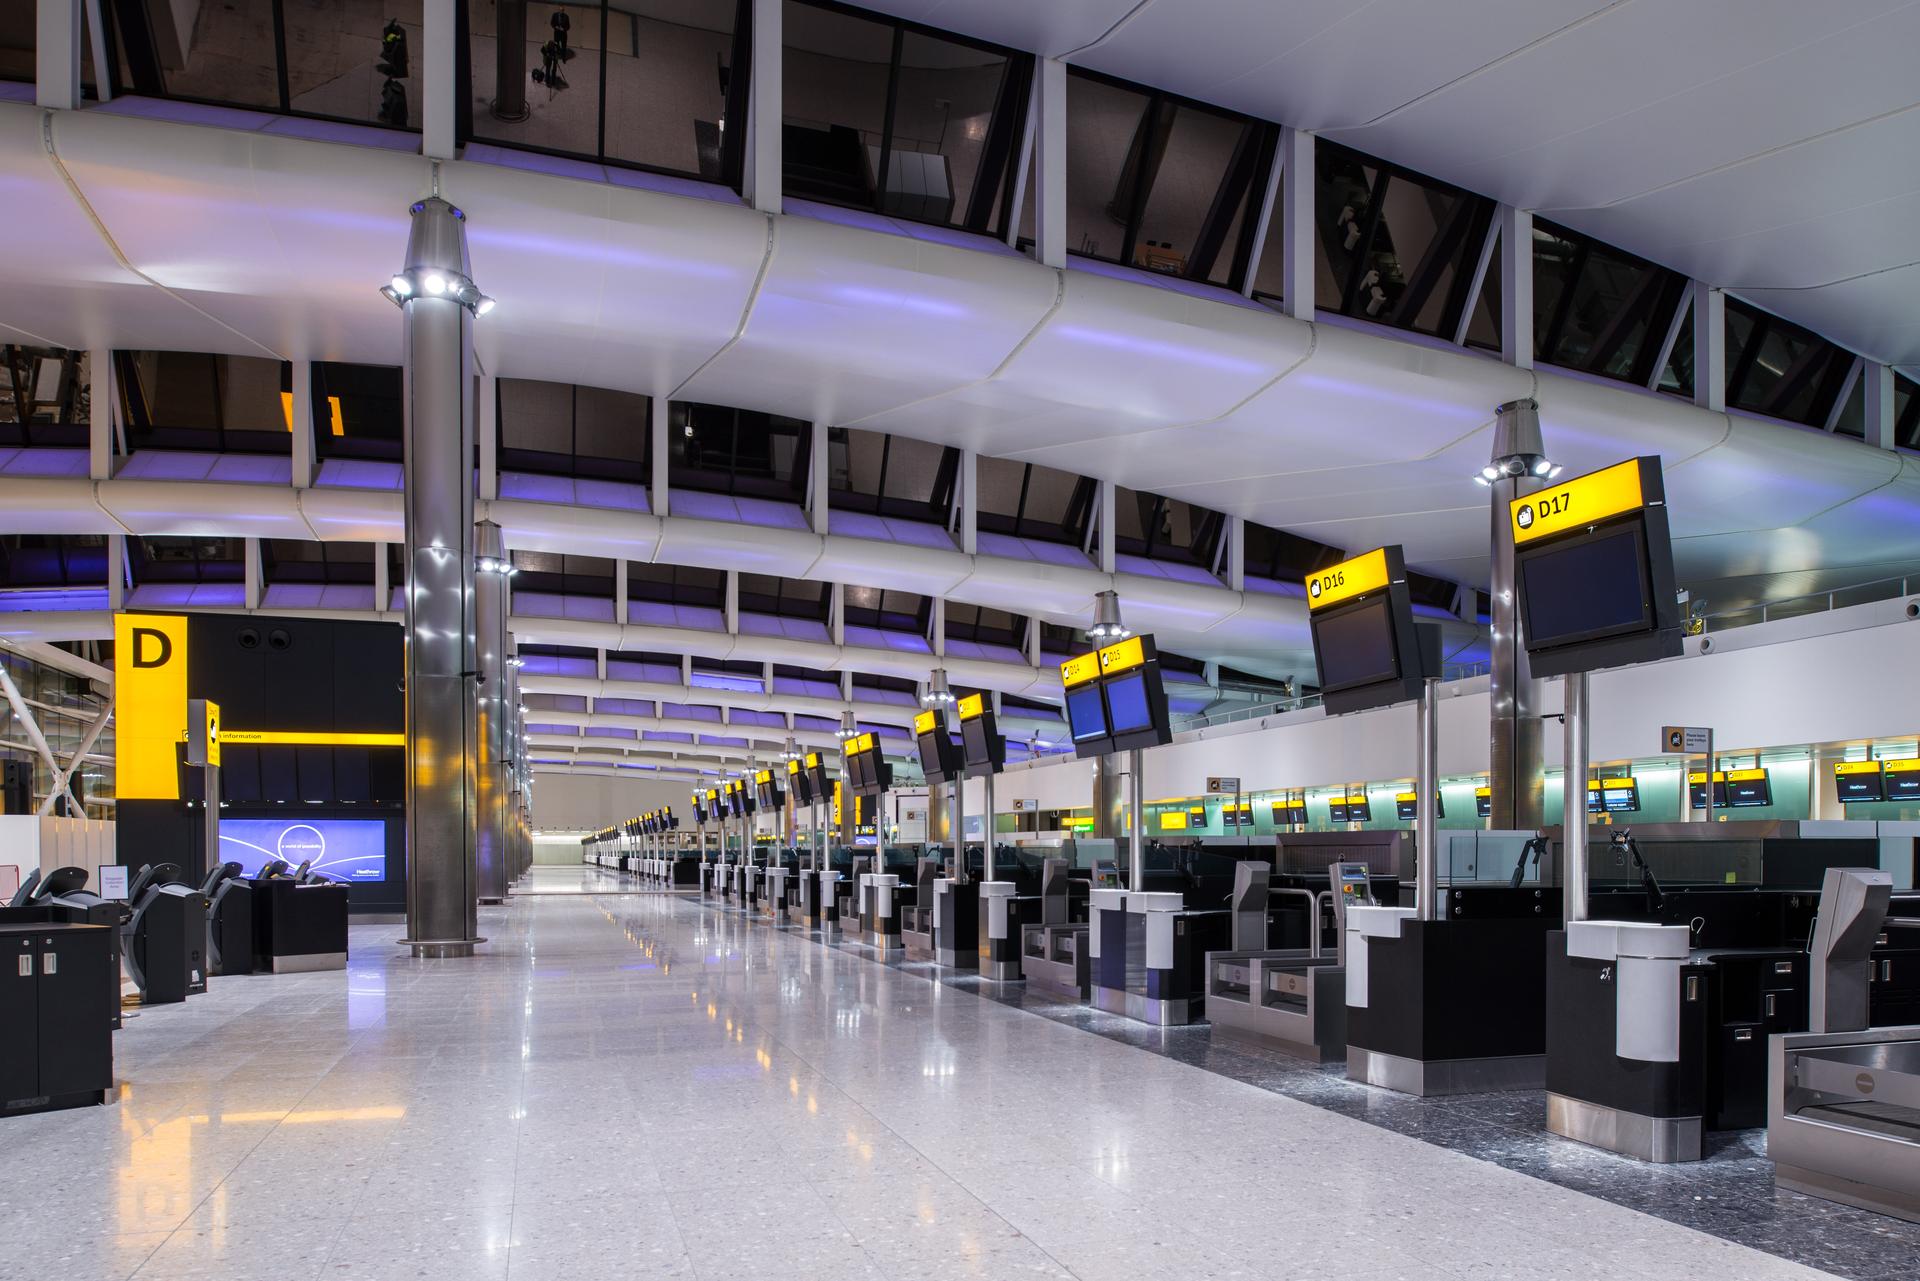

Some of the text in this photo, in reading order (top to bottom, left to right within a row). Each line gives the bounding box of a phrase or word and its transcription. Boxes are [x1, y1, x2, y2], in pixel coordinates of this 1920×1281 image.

[1538, 492, 1570, 519] D17
[1323, 571, 1345, 591] D16
[132, 627, 173, 669] D
[1109, 649, 1121, 662] D15
[223, 733, 262, 741] information
